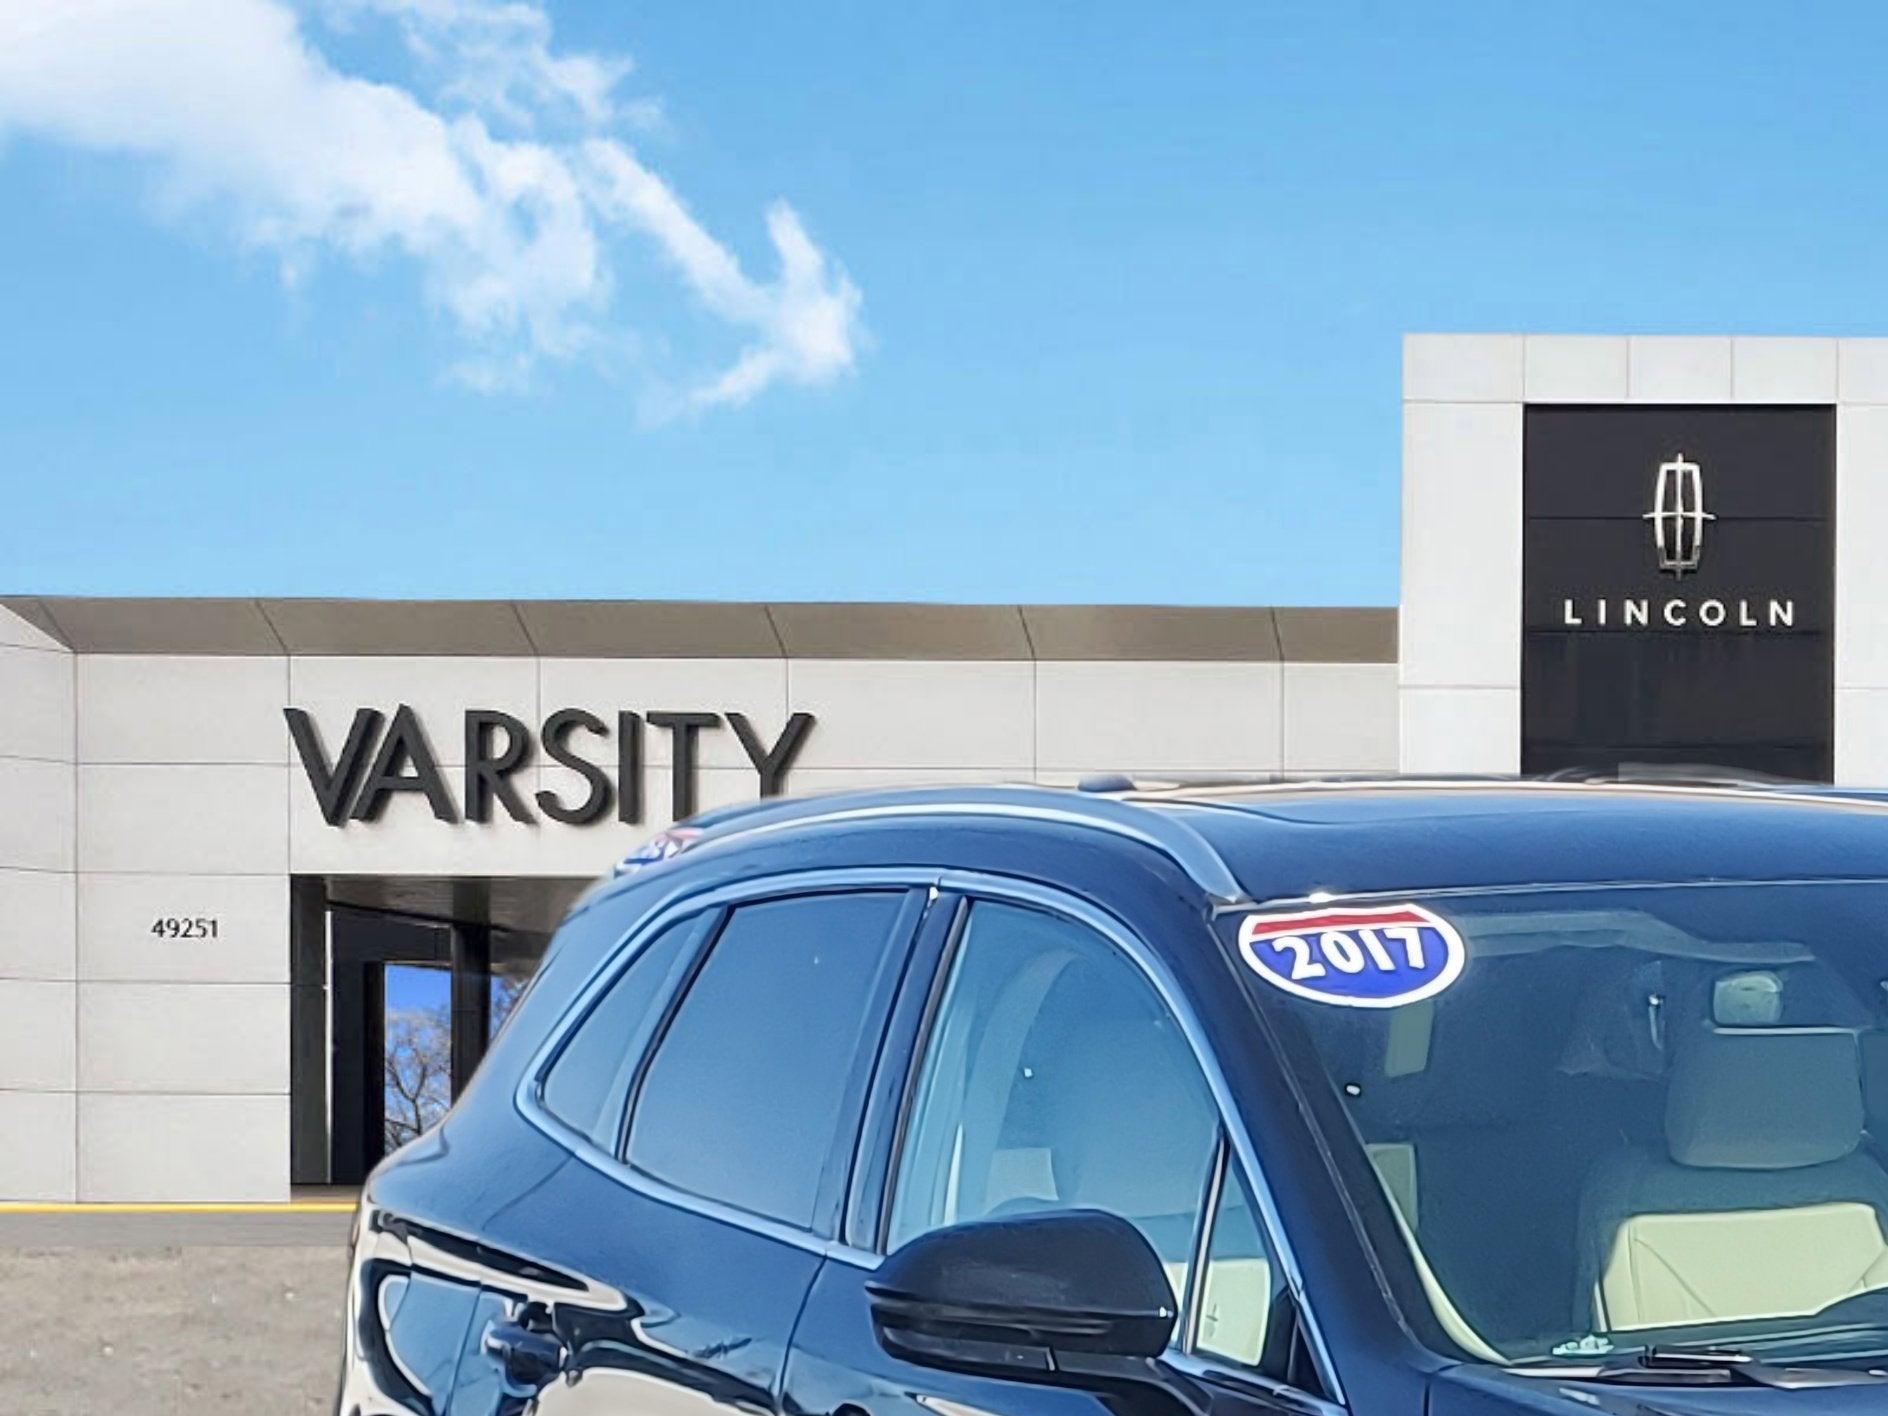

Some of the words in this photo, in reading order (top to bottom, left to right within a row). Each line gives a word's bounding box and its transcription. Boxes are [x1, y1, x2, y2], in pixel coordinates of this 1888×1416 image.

[1564, 598, 1795, 627] LINCOLN
[283, 703, 815, 827] VARSITY
[151, 917, 218, 938] 49251
[1273, 927, 1425, 980] 2017
